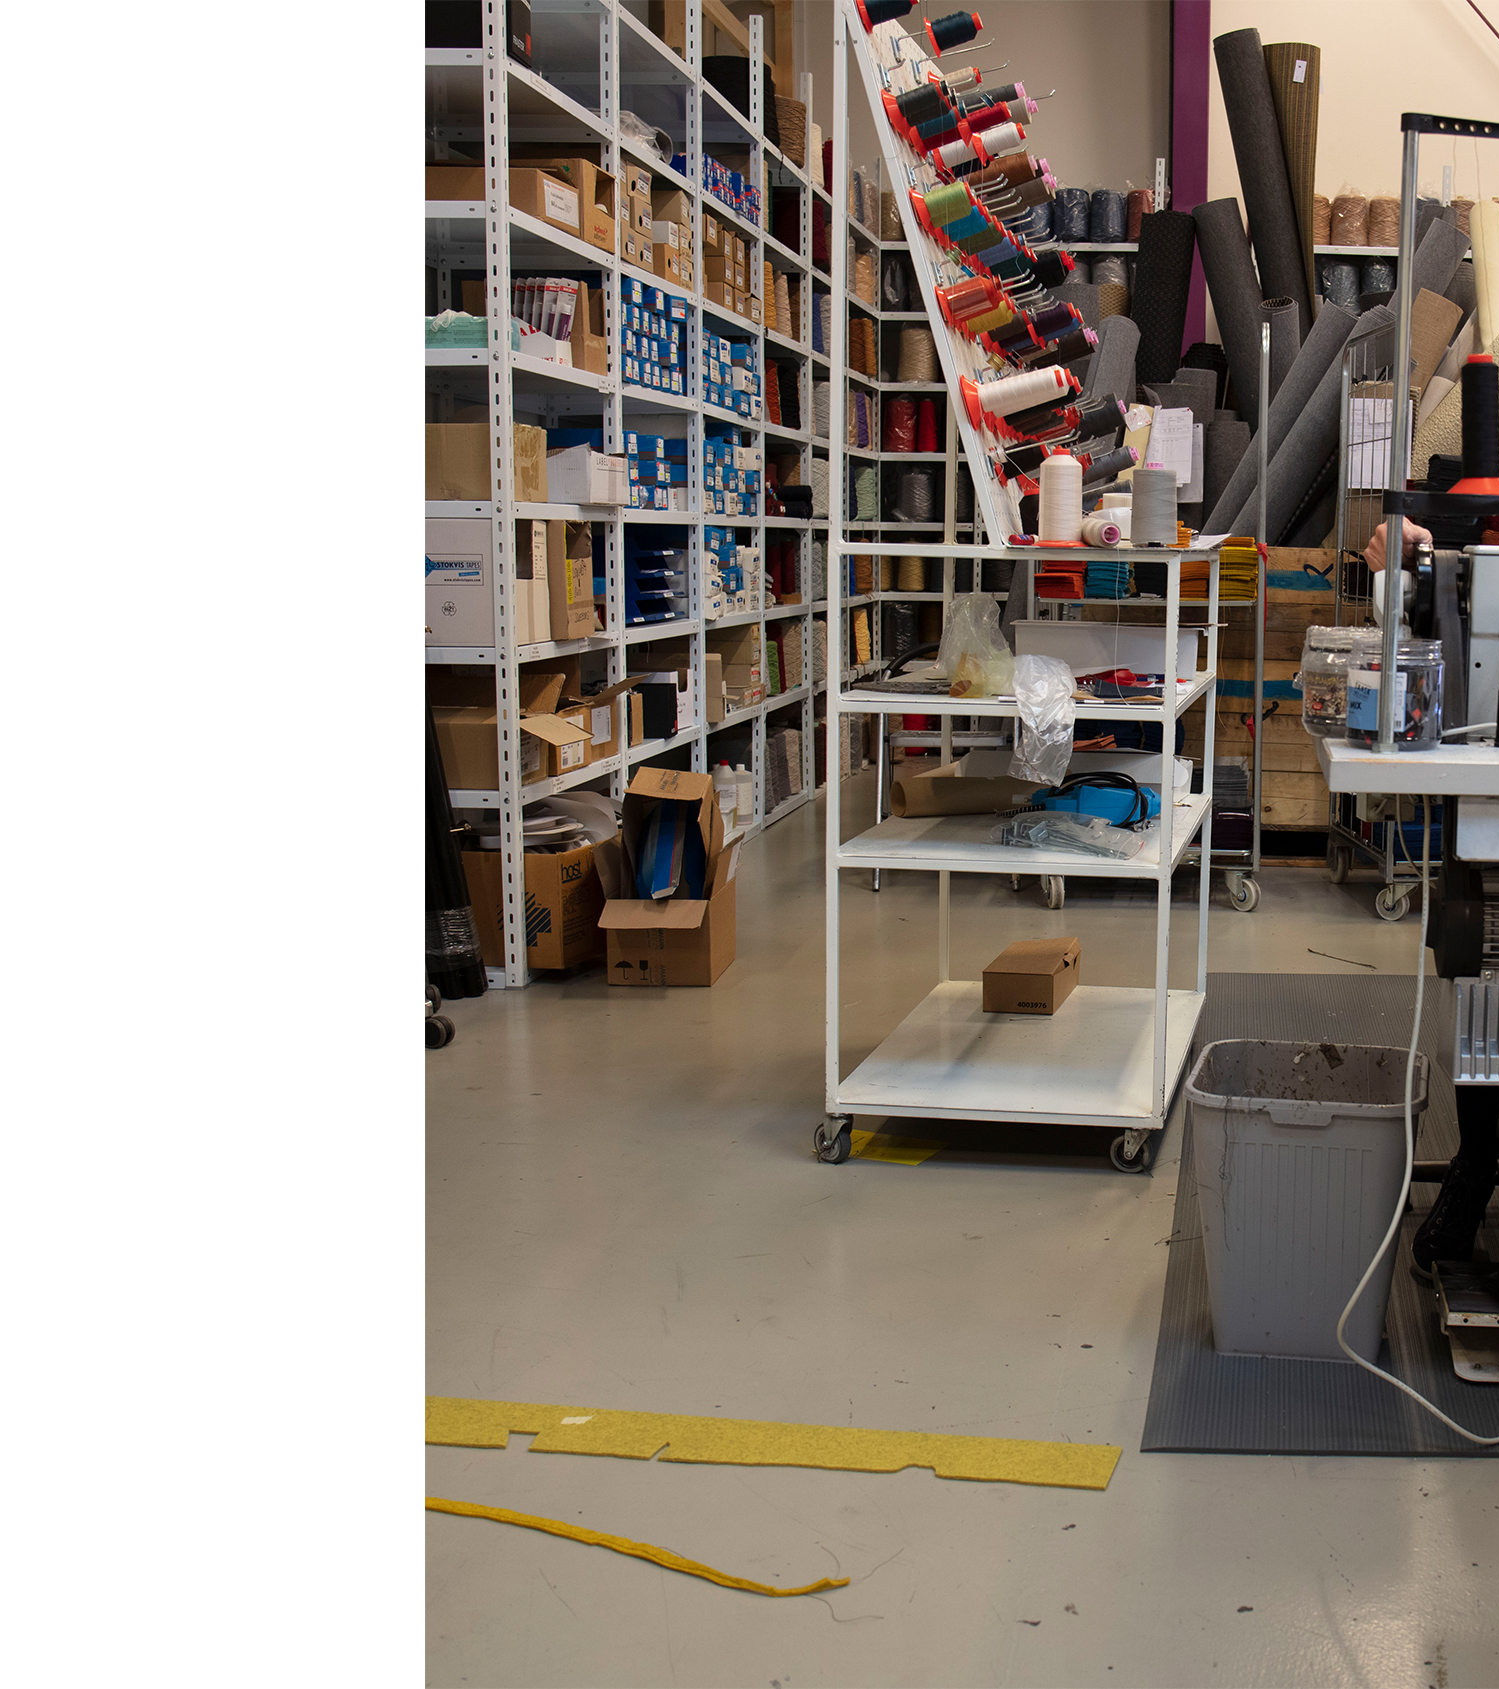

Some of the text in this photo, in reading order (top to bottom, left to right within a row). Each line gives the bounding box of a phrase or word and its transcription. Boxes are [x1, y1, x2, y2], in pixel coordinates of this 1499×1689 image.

[436, 561, 481, 569] STOKVIS TAPES
[1350, 701, 1362, 711] MIX
[561, 860, 582, 881] host
[1017, 1001, 1048, 1009] 4003976
